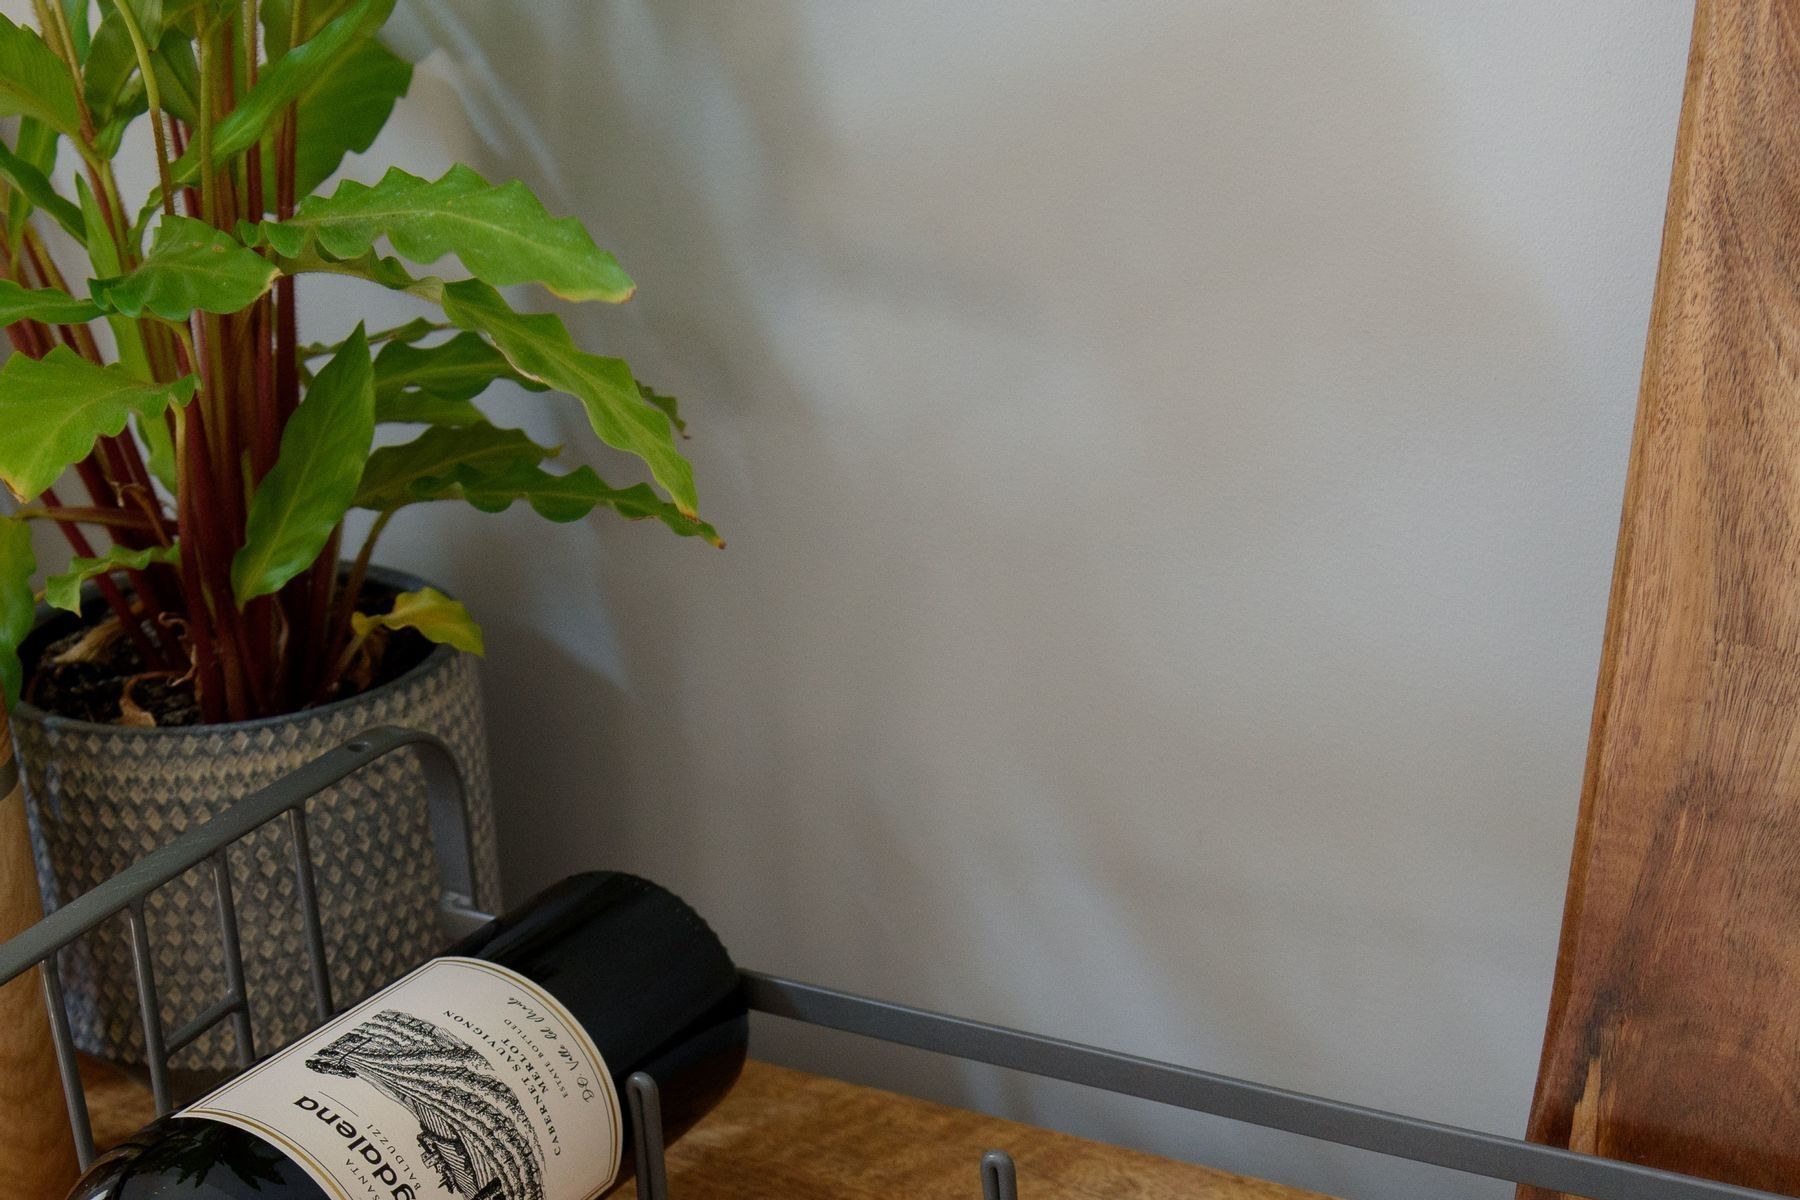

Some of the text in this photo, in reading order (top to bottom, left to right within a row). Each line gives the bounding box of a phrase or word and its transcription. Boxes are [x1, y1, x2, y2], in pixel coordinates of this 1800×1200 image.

[443, 1010, 561, 1157] CABERNET SAUVIGNON
[501, 1038, 549, 1094] MERLOT
[503, 1018, 569, 1099] ESTATE BOTTLED
[366, 1124, 421, 1191] BALDUZZI
